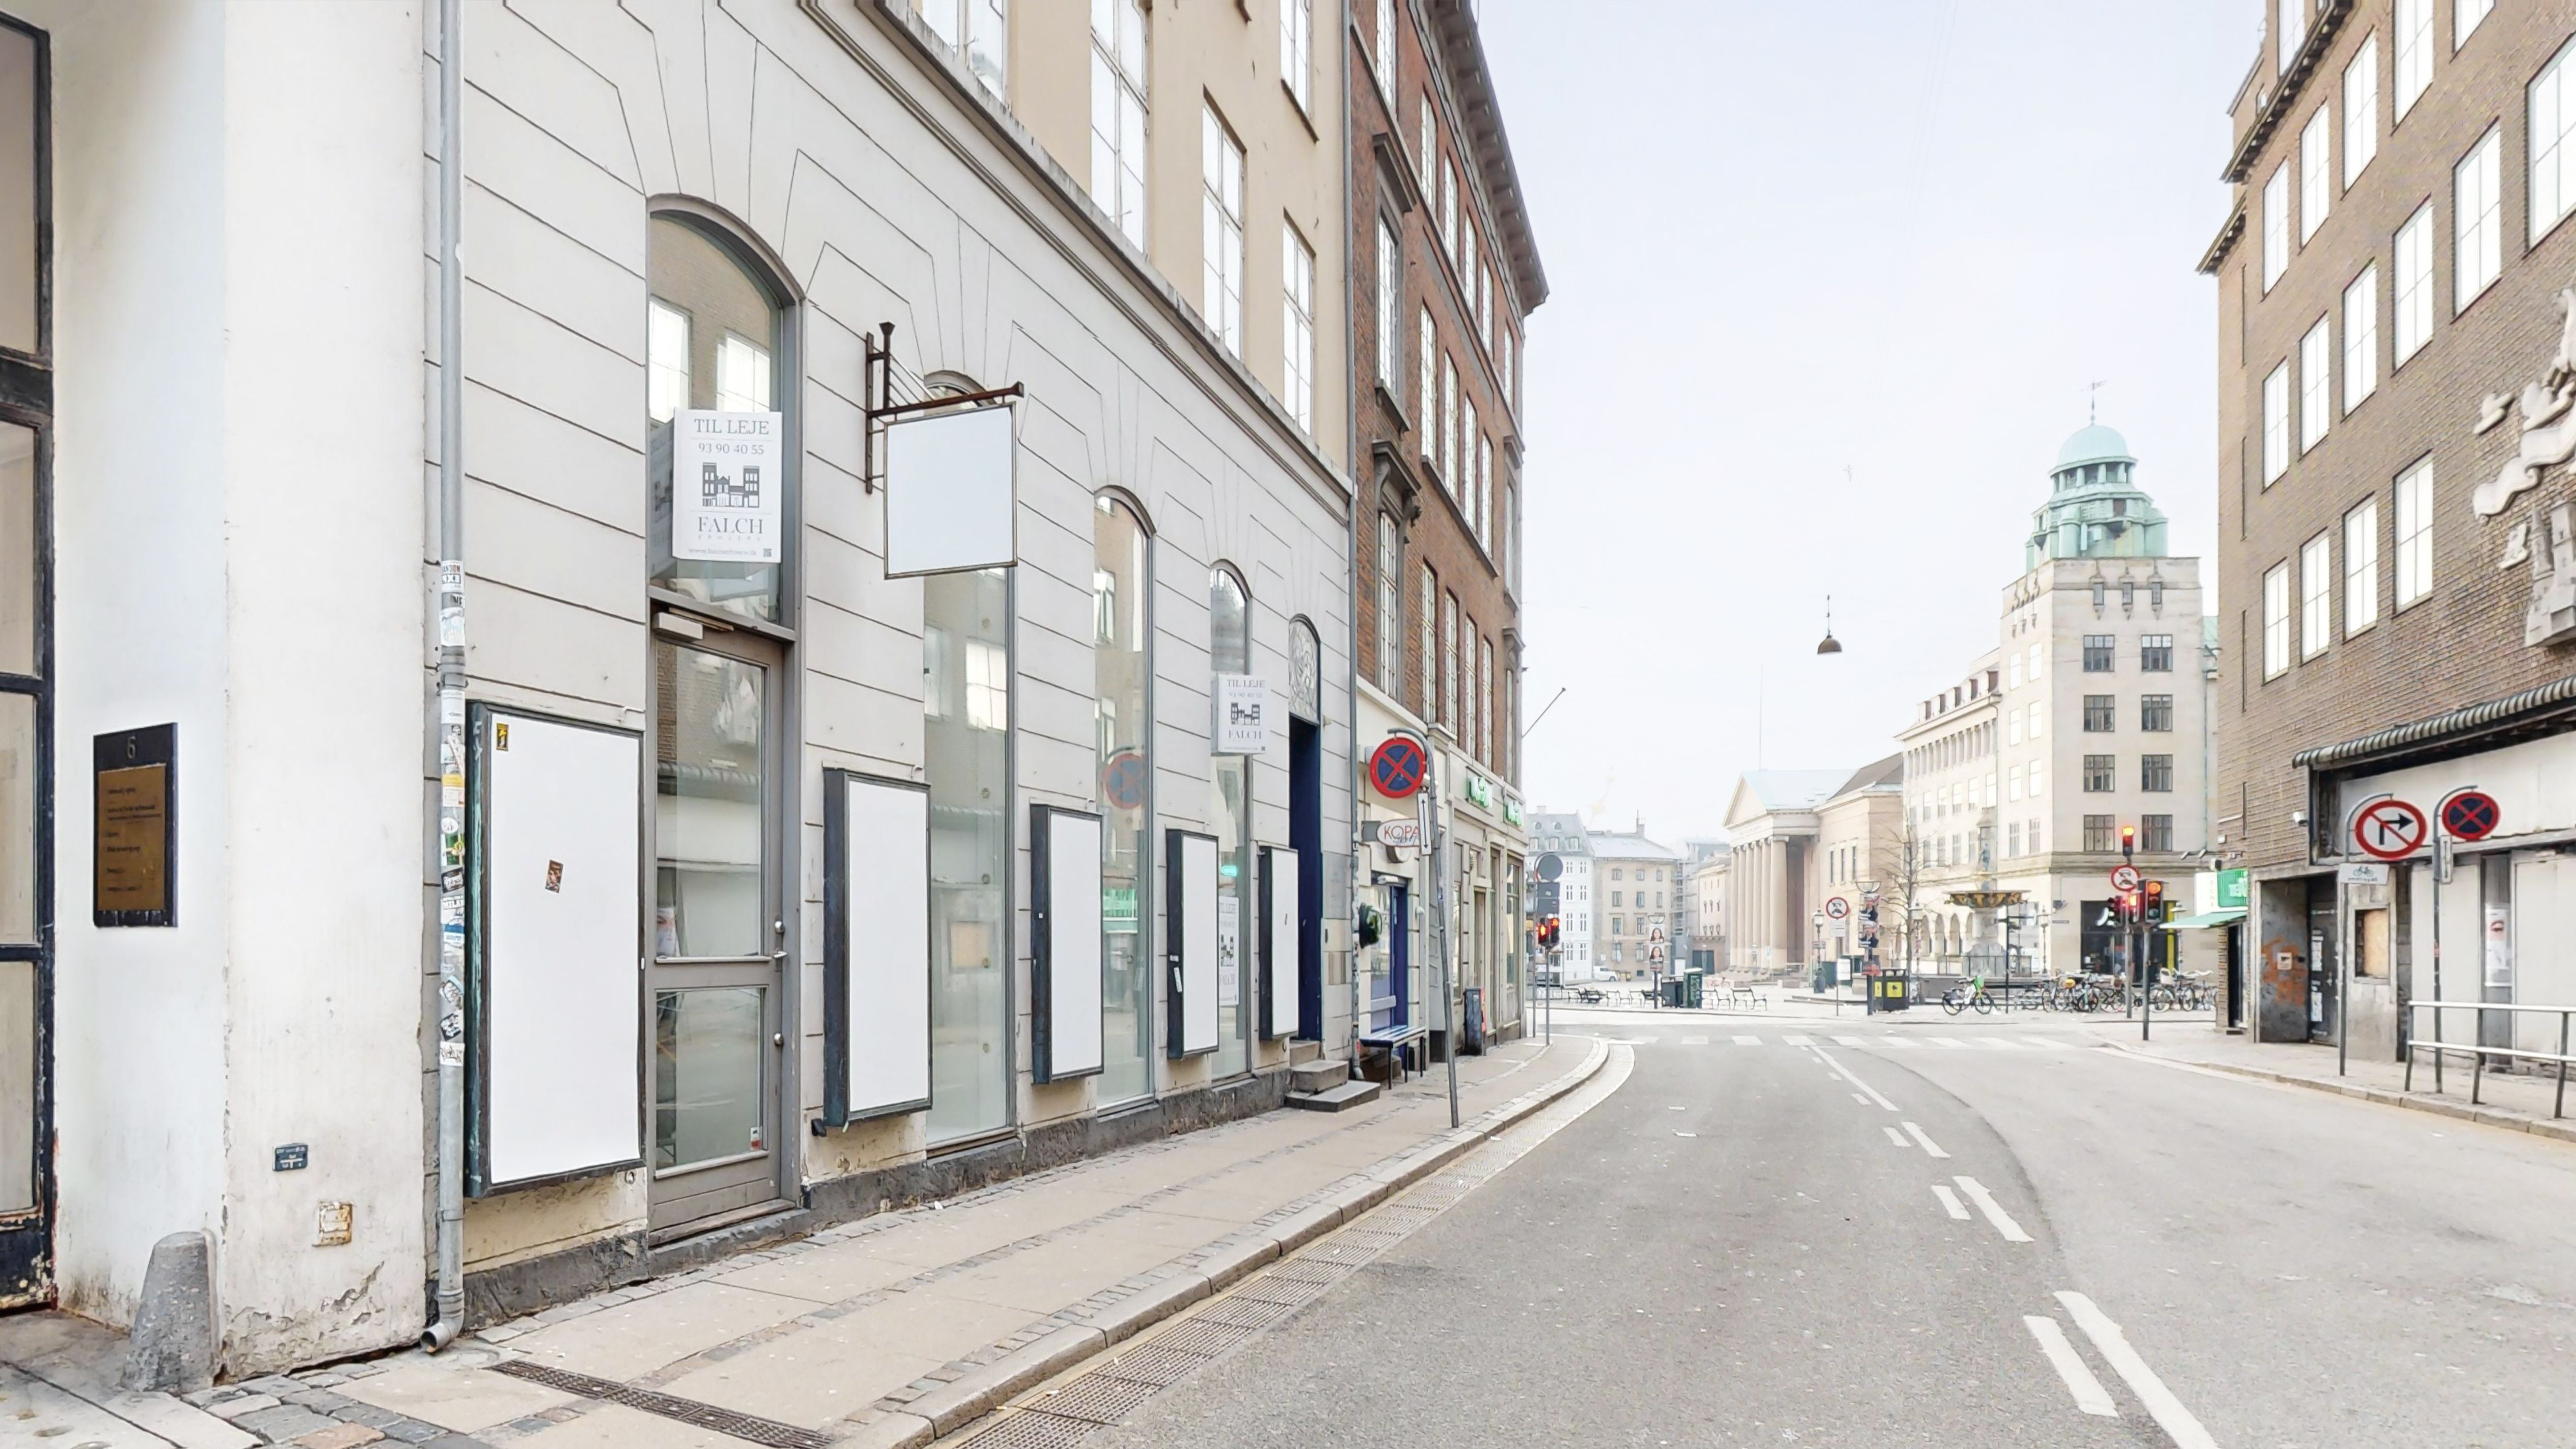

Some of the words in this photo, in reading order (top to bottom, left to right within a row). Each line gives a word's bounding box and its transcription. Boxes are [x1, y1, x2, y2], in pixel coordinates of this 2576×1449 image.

[694, 418, 722, 433] TIL
[726, 419, 769, 435] LEJE
[698, 442, 712, 454] 93
[716, 443, 730, 454] 90
[734, 444, 748, 454] 40
[751, 445, 764, 455] 55
[698, 516, 763, 534] FALCH
[1227, 679, 1241, 688] TIL
[1243, 679, 1265, 688] LEJE
[1228, 730, 1262, 740] FALCH
[127, 736, 137, 759] 6
